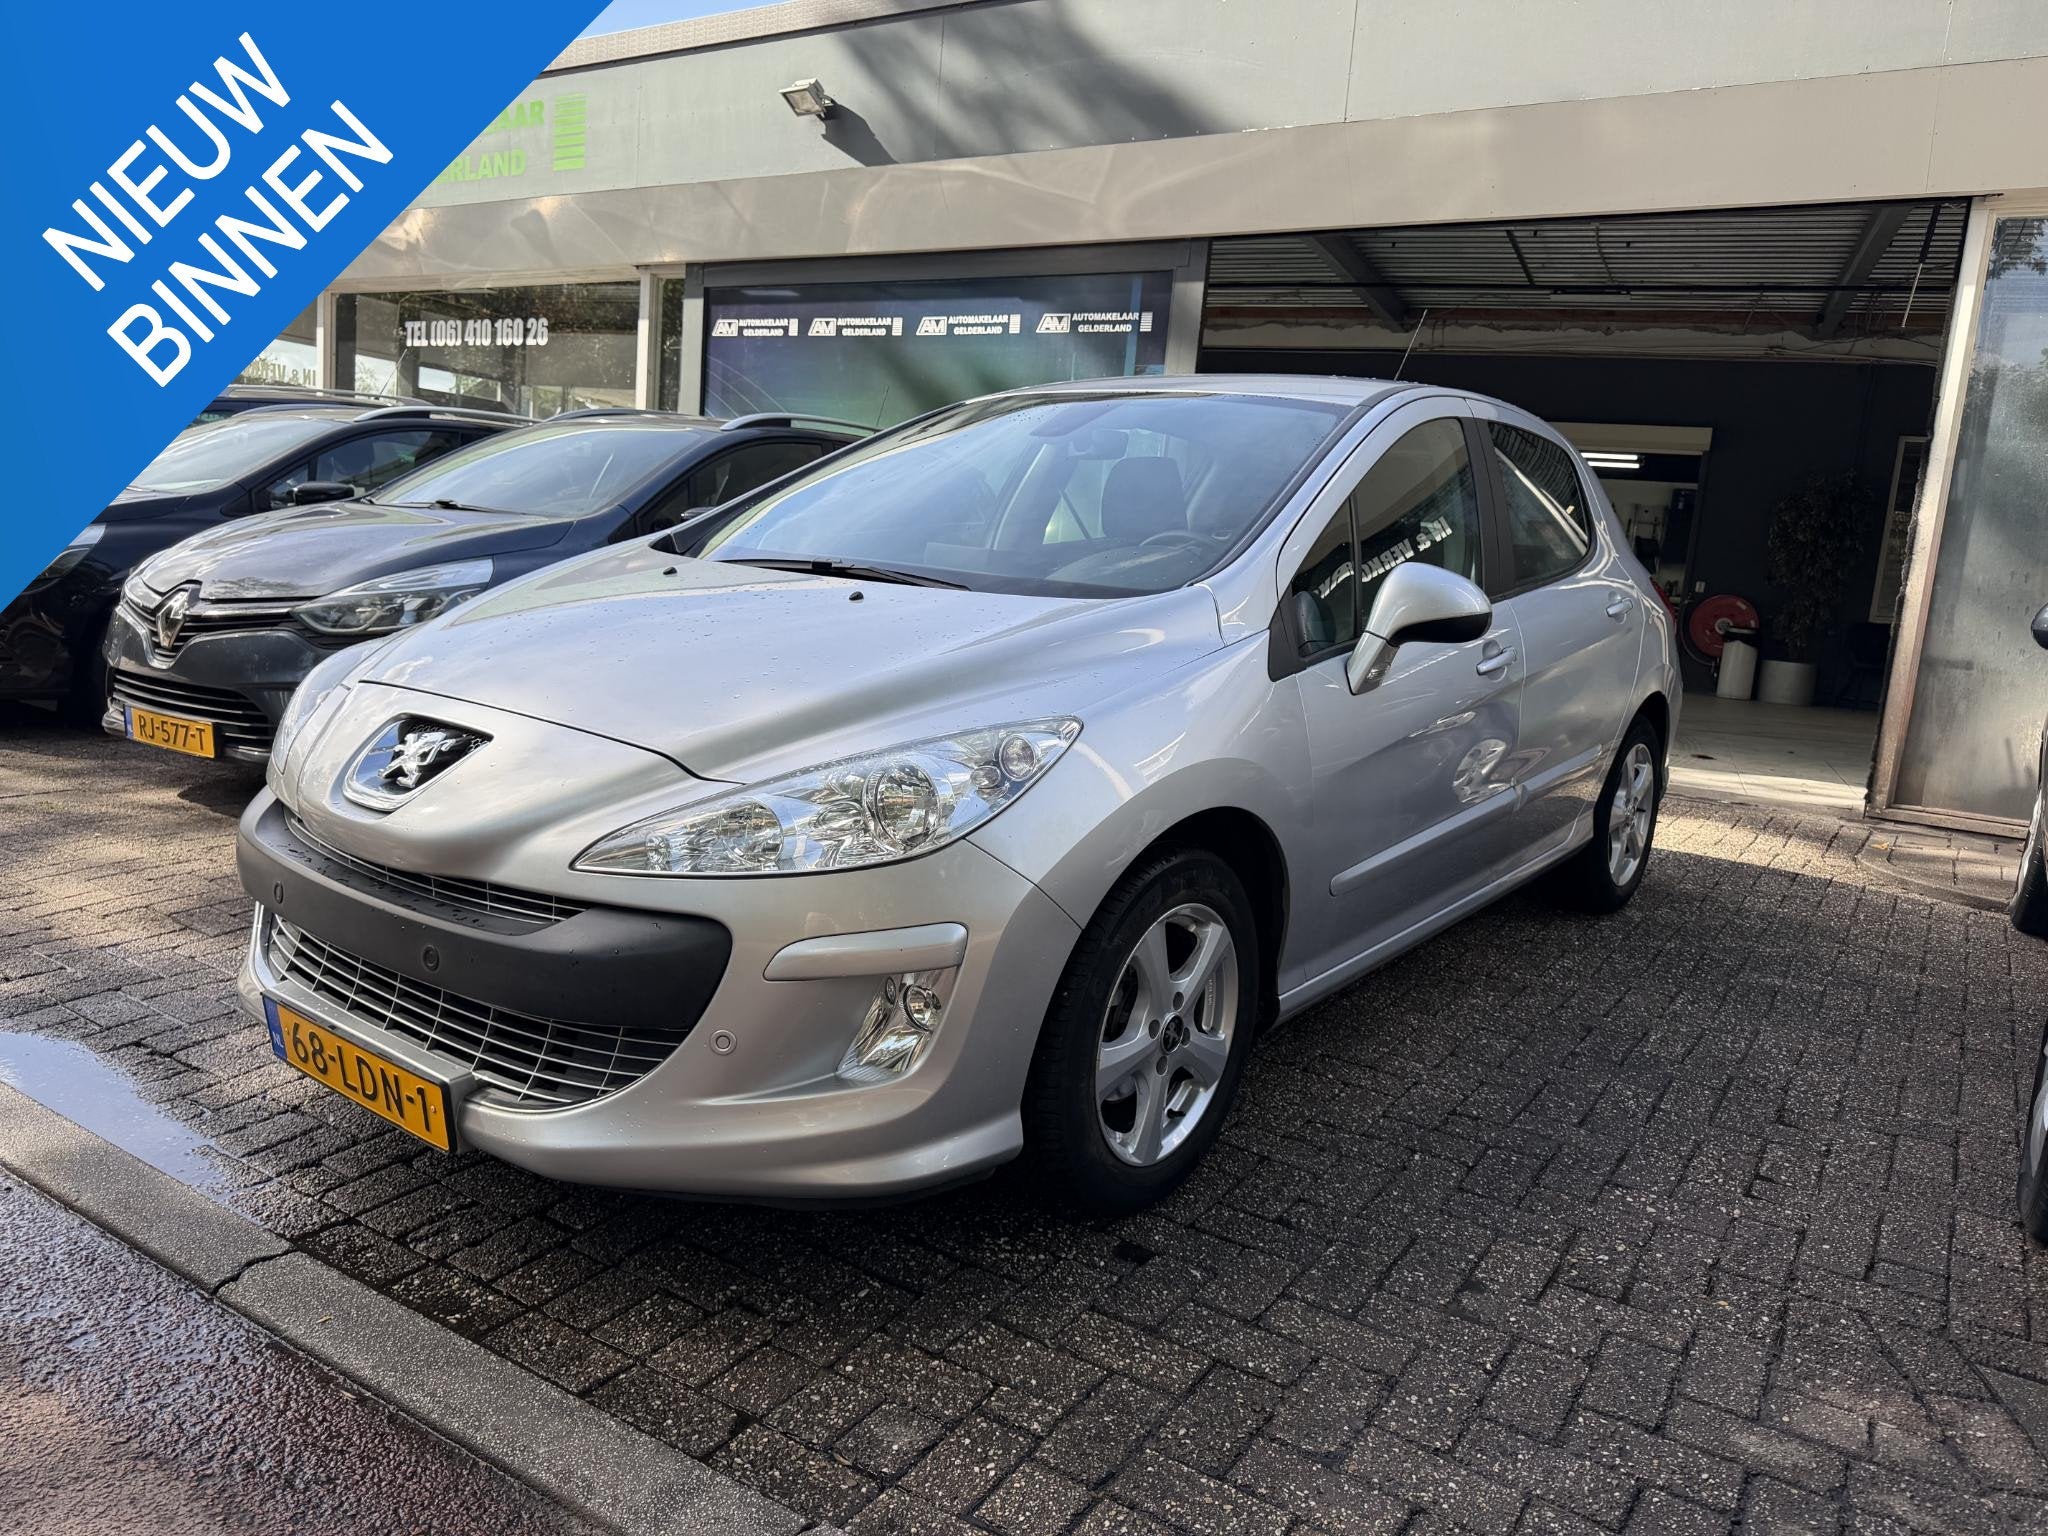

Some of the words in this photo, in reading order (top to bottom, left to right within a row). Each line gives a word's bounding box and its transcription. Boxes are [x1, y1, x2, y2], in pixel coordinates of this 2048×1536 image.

[486, 98, 545, 134] AAR
[948, 315, 1008, 324] AUTOMAKELAAR
[1072, 312, 1140, 321] AUTOMAKELAAR
[739, 318, 788, 327] AUTOMAKELAAR
[837, 317, 892, 326] AUTOMAKELAAR
[405, 320, 428, 347] TEL
[430, 319, 463, 347] (06)
[464, 318, 492, 346] 410
[495, 317, 524, 346] 160
[526, 317, 549, 346] 26
[742, 328, 784, 337] GELDERLAND
[841, 327, 886, 336] GELDERLAND
[953, 326, 1003, 335] GELDERLAND
[1077, 323, 1132, 333] GELDERLAND
[138, 714, 206, 752] RJ-577-T
[291, 1021, 431, 1133] 68-LDN-1
